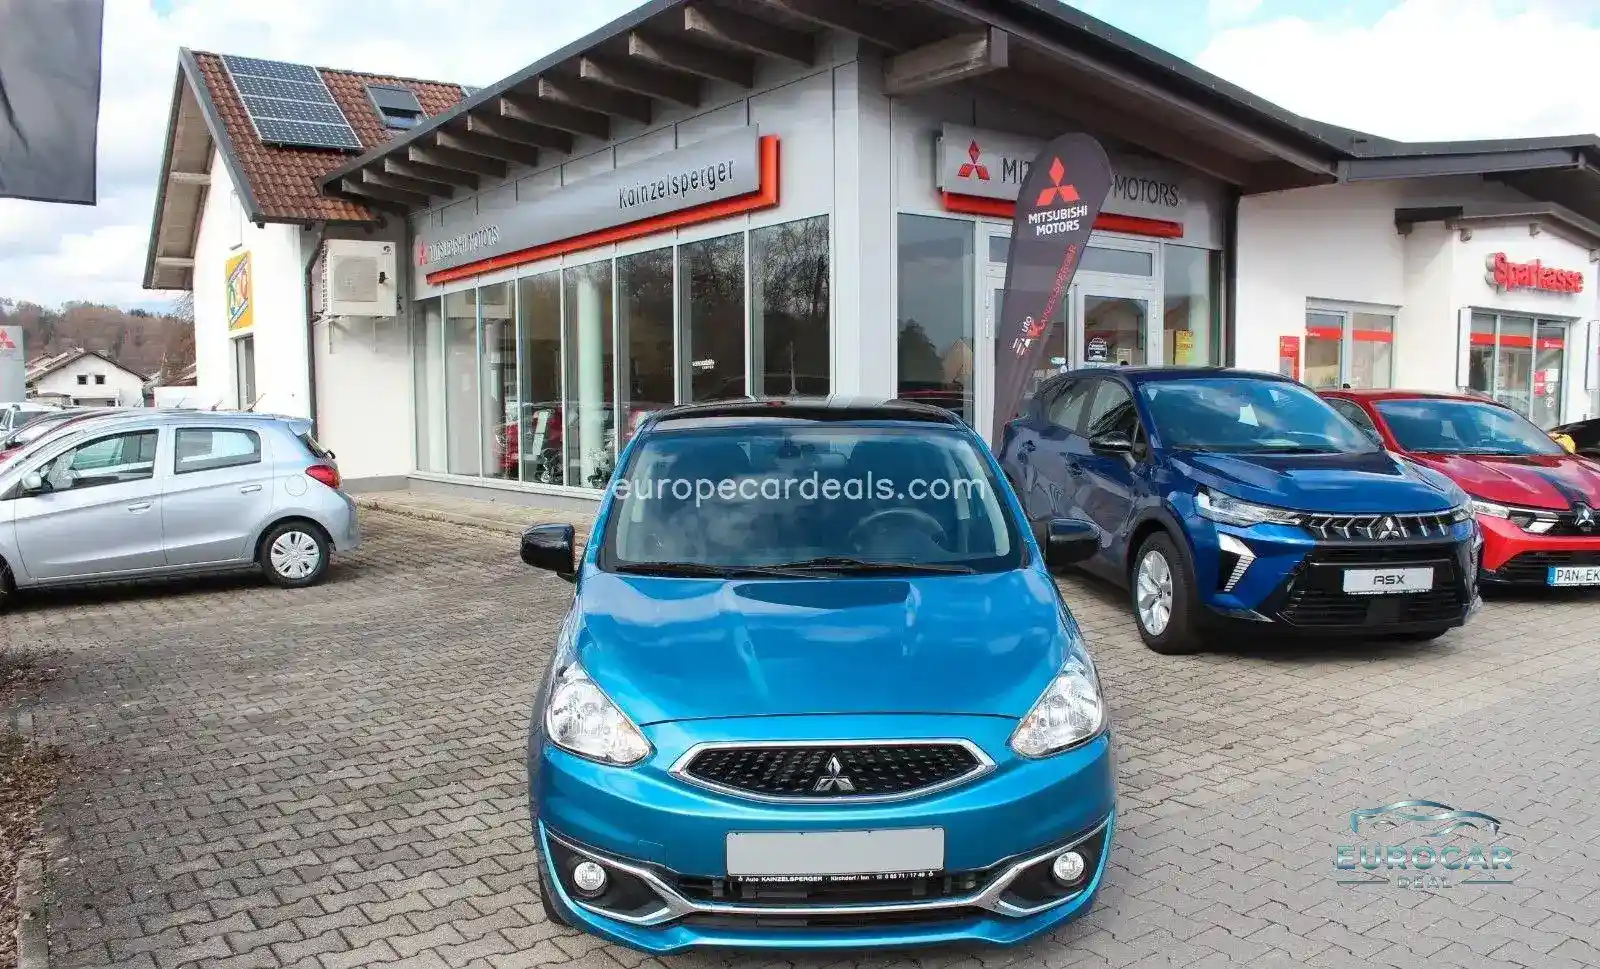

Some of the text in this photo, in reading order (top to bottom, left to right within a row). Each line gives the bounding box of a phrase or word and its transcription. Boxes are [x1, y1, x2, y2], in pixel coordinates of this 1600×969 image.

[619, 160, 734, 209] Kainzelsperger
[1113, 173, 1180, 207] MOTORS
[1028, 205, 1088, 224] MITSUBISHI
[1036, 219, 1080, 236] MOTORS
[1485, 252, 1583, 294] Sparkasse
[1373, 574, 1405, 585] ASX
[1557, 569, 1580, 581] PAN
